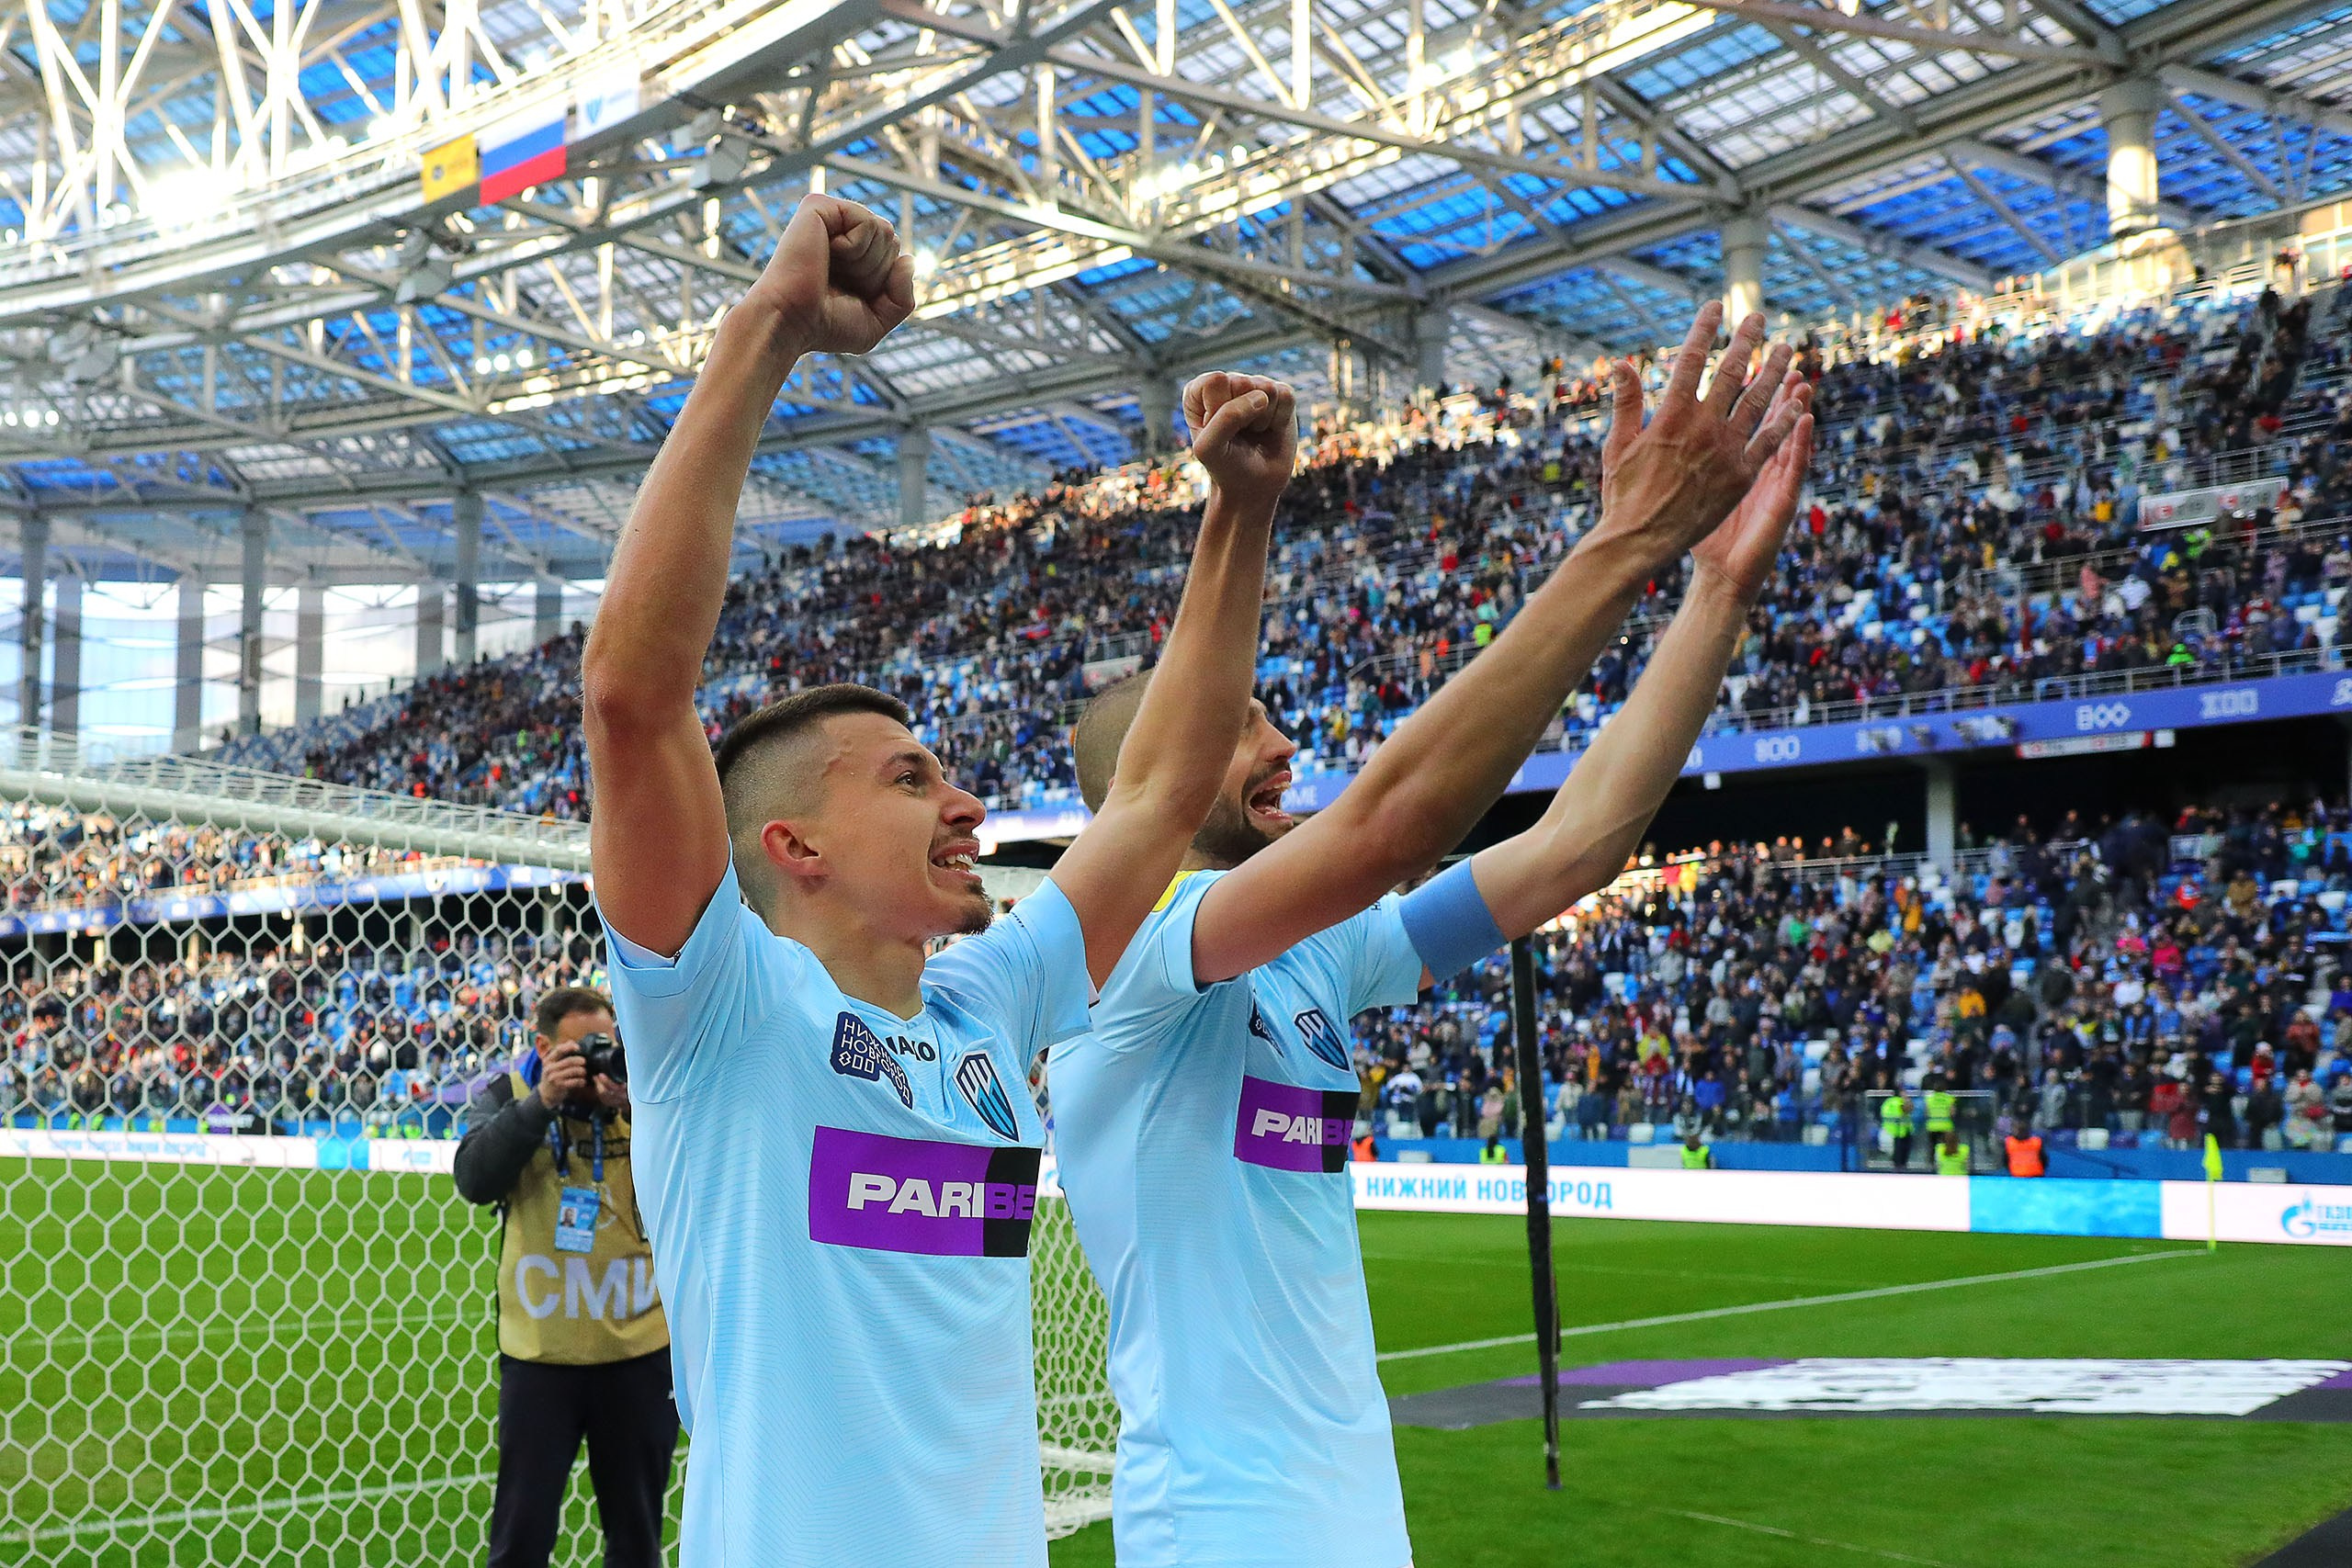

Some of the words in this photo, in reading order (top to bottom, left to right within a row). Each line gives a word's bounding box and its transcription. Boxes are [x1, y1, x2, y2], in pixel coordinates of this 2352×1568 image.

[841, 1033, 910, 1105] НОВГОРОД
[843, 1018, 906, 1085] НИЖНИЙ
[1366, 1173, 1467, 1200] НИЖНИЙ
[1477, 1179, 1613, 1210] НОВОРОД
